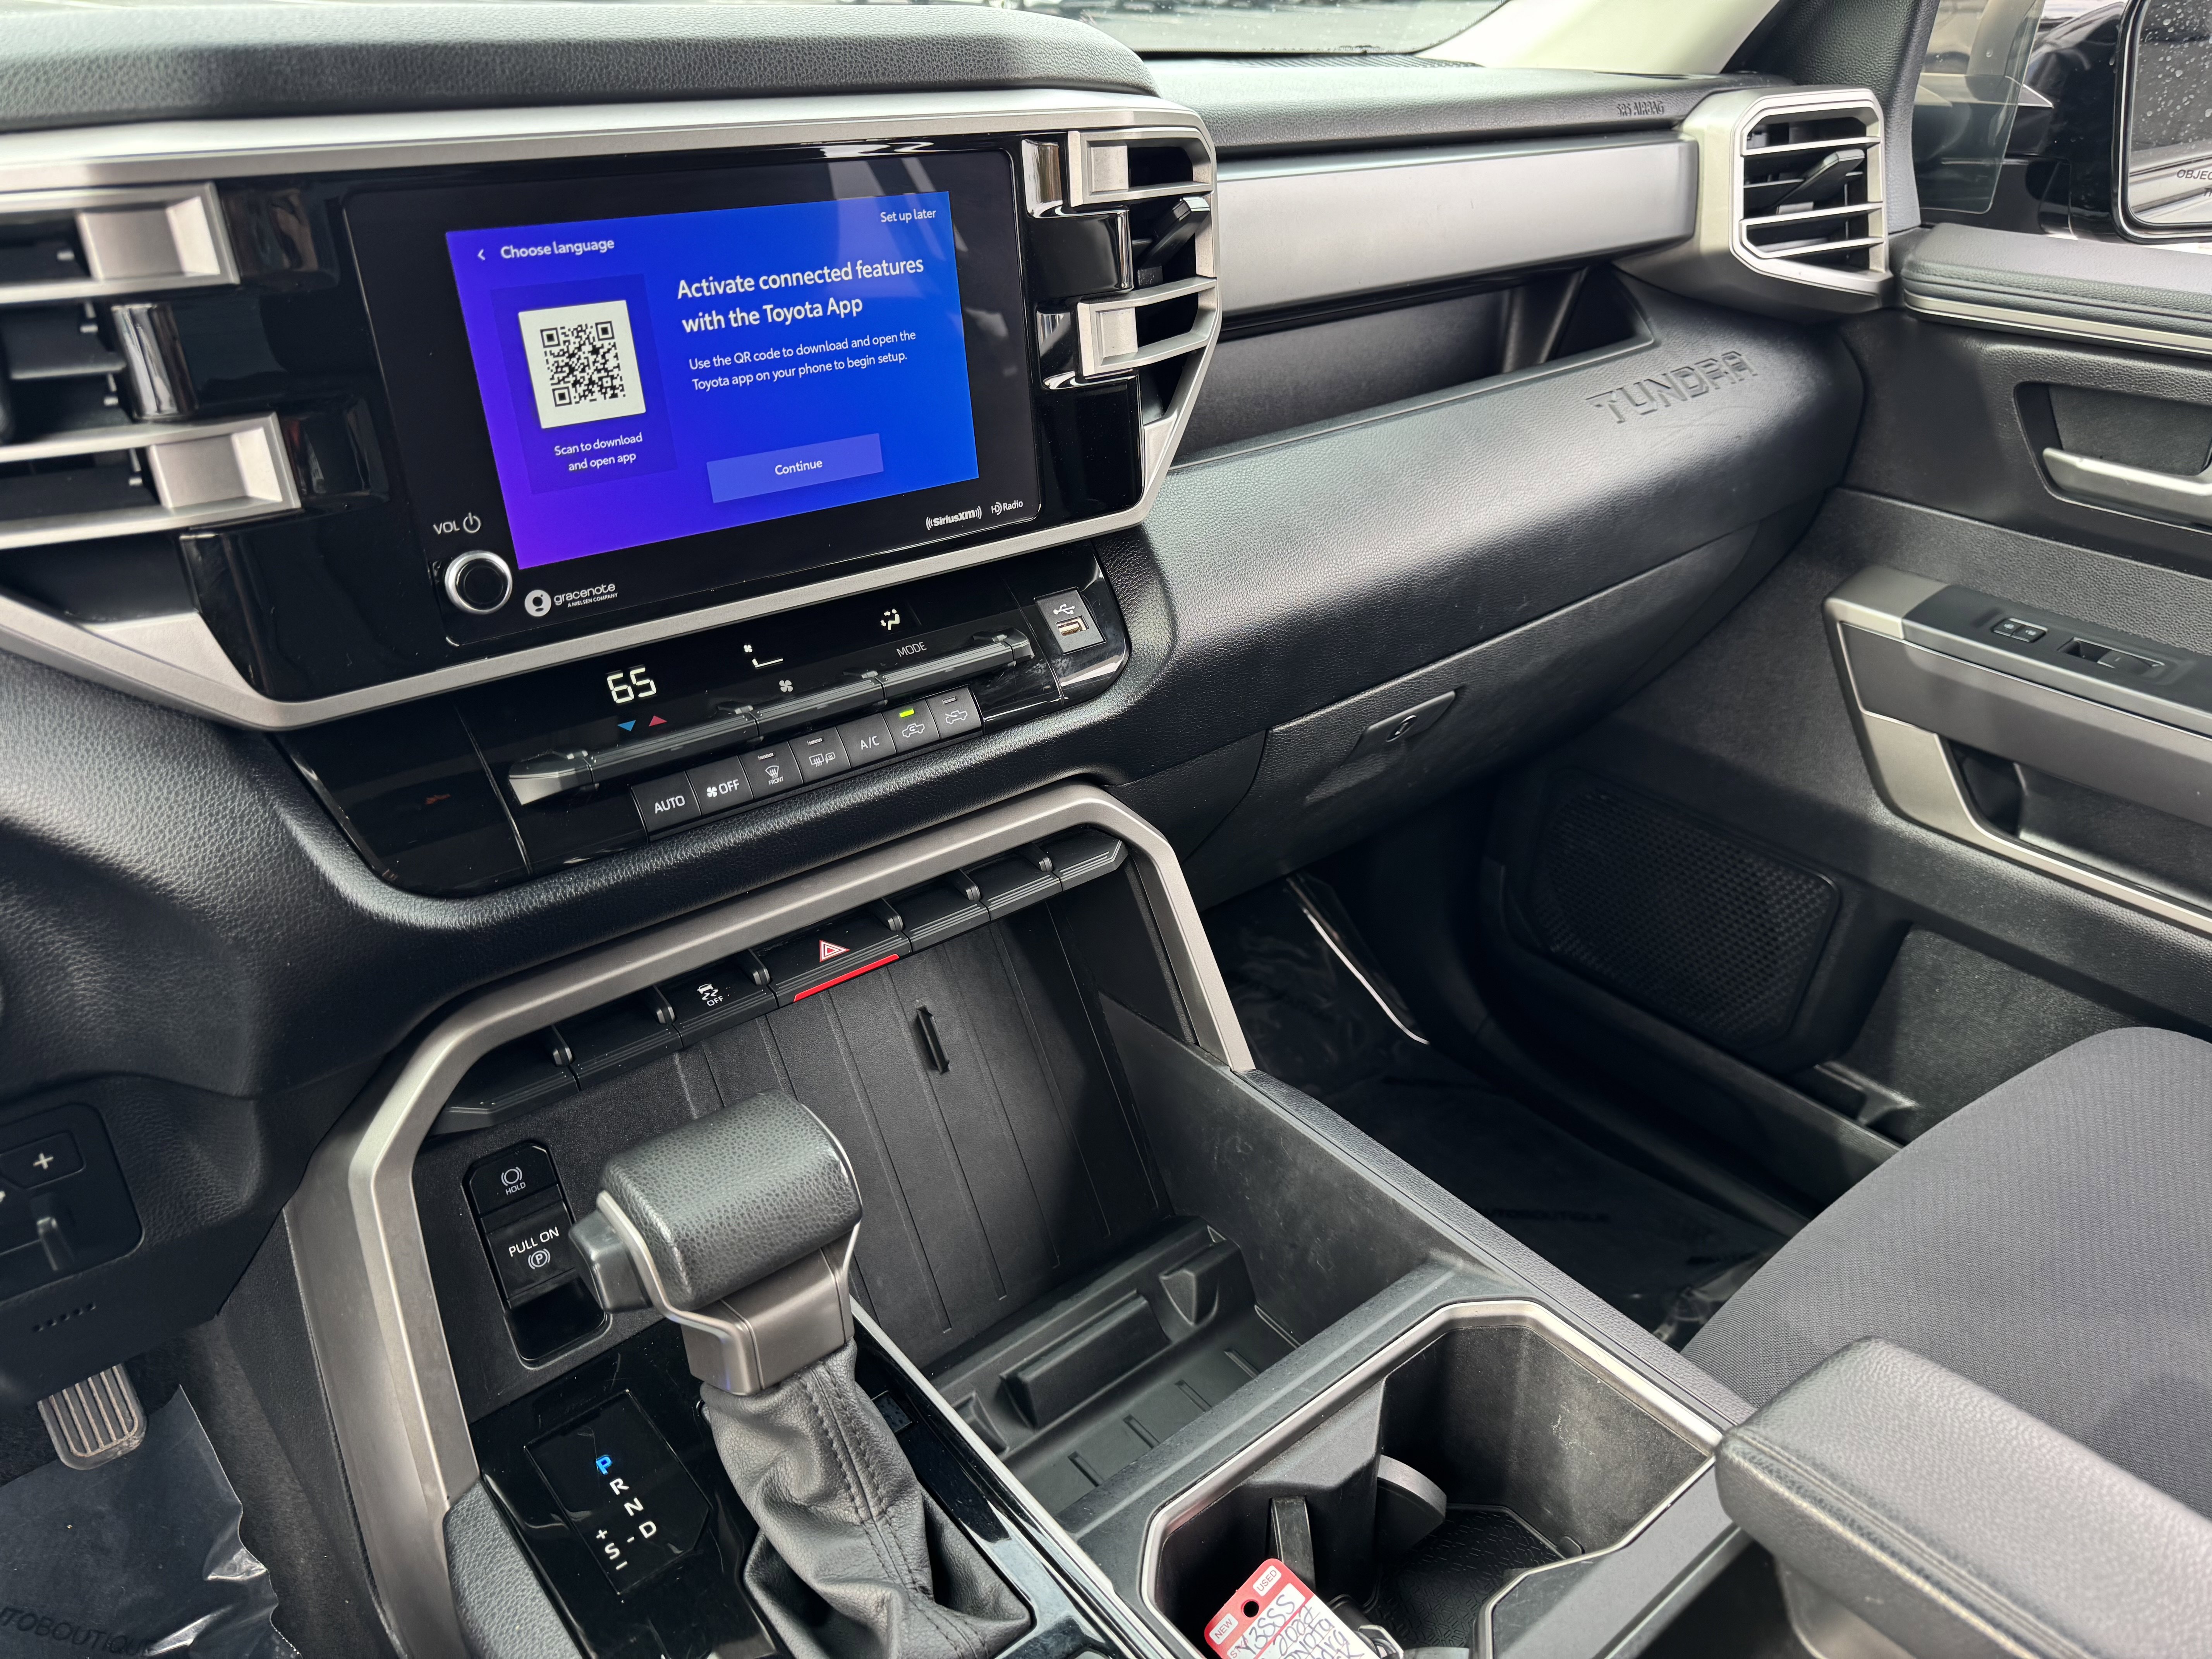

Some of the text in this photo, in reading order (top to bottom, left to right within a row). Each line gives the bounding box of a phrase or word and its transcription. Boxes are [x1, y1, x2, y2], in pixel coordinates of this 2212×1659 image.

[1617, 101, 1664, 116] SRS AIRBAG
[880, 209, 936, 222] Set up later
[500, 240, 615, 259] Choose language
[678, 258, 924, 299] Activate connected features
[682, 297, 863, 333] with the Toyota App
[689, 330, 916, 370] Use the QR code to download and open the
[692, 351, 908, 392] Toyota app on your phone to begin setup.
[1586, 351, 1758, 424] TUNDRA
[554, 432, 643, 456] Scan to download
[568, 453, 637, 471] and open app
[774, 458, 823, 476] Continue
[991, 500, 1024, 515] HD Radio
[433, 520, 460, 535] VOL
[554, 583, 616, 606] gracenote
[572, 598, 593, 607] NIELSEN
[593, 592, 618, 603] COMPANY
[896, 641, 927, 658] MODE
[607, 666, 657, 704] 65
[860, 735, 880, 750] A/C
[718, 778, 740, 795] OFF
[768, 776, 784, 786] FRONT
[654, 794, 686, 814] AUTO
[706, 995, 724, 1006] OFF
[505, 1182, 526, 1195] HOLD
[508, 1226, 560, 1257] PULL ON
[596, 1455, 613, 1475] P
[609, 1478, 629, 1495] R
[624, 1497, 644, 1516] N
[639, 1521, 657, 1539] D
[604, 1542, 620, 1560] S
[1257, 1569, 1277, 1592] USED
[0, 1606, 155, 1658] TOBOUTIQU
[1214, 1618, 1232, 1640] NEW
